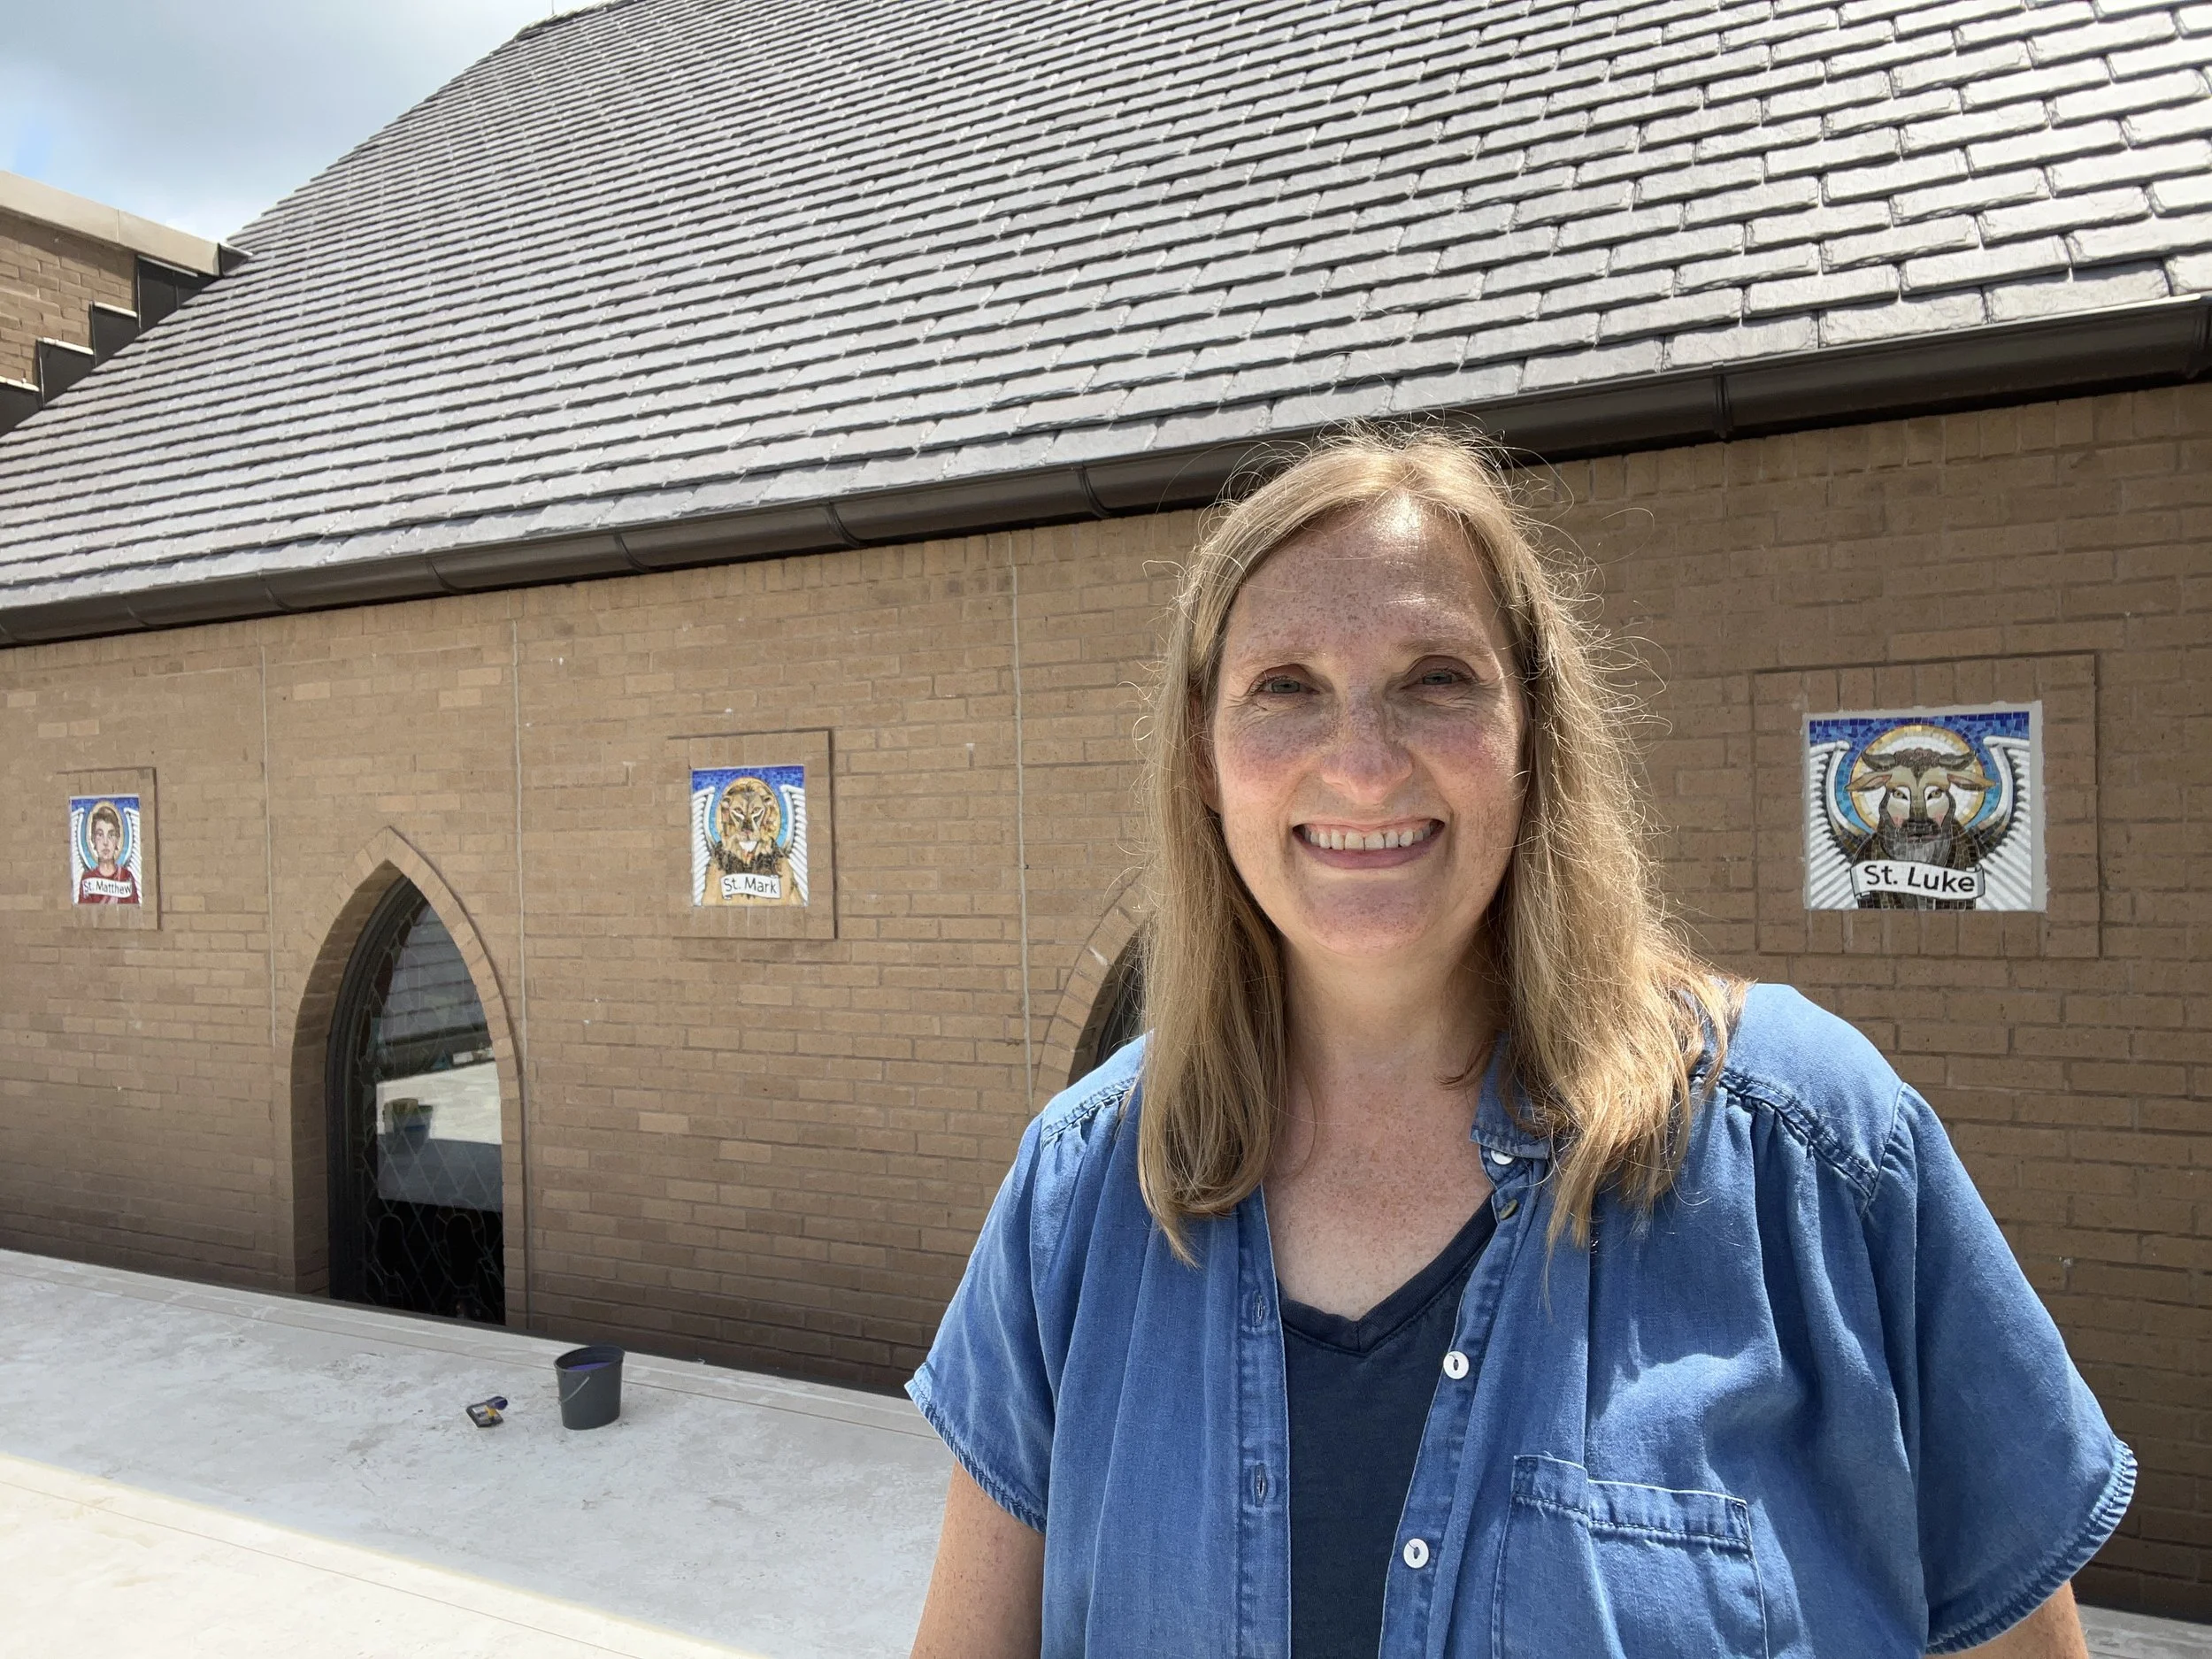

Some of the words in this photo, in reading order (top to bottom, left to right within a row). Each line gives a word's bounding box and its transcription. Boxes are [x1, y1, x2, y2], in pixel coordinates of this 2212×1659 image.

[723, 878, 741, 892] St.
[744, 877, 778, 894] Mark
[1864, 864, 1898, 886] St.
[1908, 866, 1975, 893] Luke
[83, 880, 95, 893] St.
[96, 880, 132, 895] Matthew
